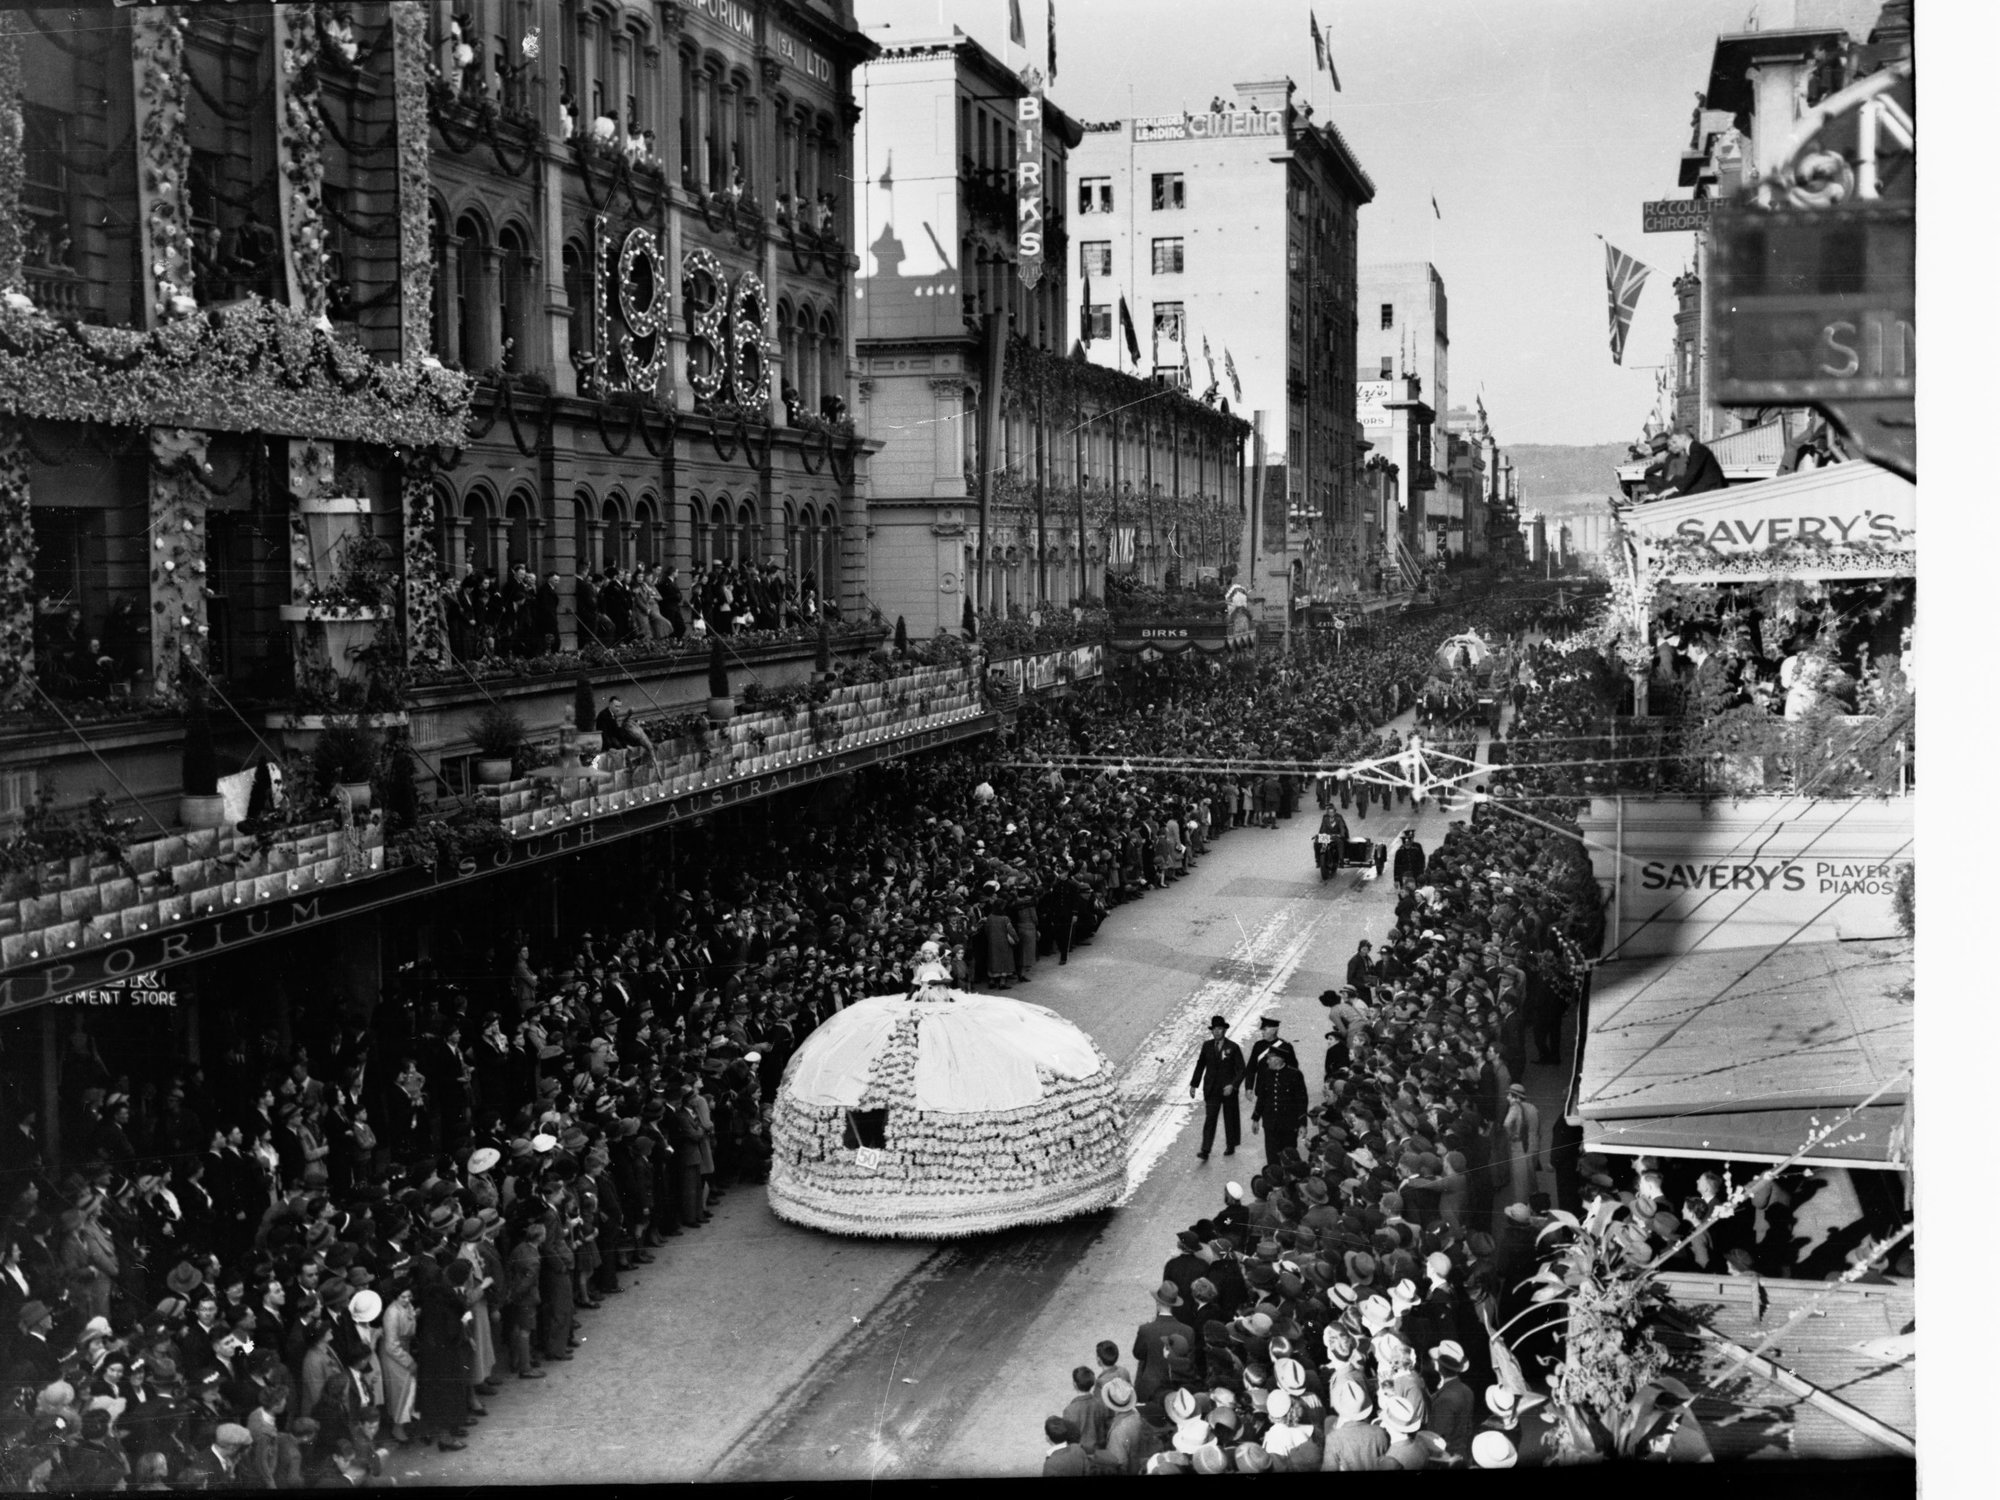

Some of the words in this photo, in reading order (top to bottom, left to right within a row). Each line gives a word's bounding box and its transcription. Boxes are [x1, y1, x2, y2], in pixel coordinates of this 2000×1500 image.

[1136, 126, 1186, 141] LEADING
[1188, 111, 1283, 137] CINEMA
[1018, 96, 1042, 256] BIRKS
[594, 213, 773, 412] 1936
[1676, 509, 1900, 545] SAVERY'S
[1141, 628, 1189, 638] BIRKS
[1642, 860, 1806, 891] SAVERY'S
[1816, 862, 1891, 879] PLAYER
[1820, 878, 1894, 895] PIANOS
[130, 990, 178, 1007] STORE
[857, 1148, 878, 1167] 50
